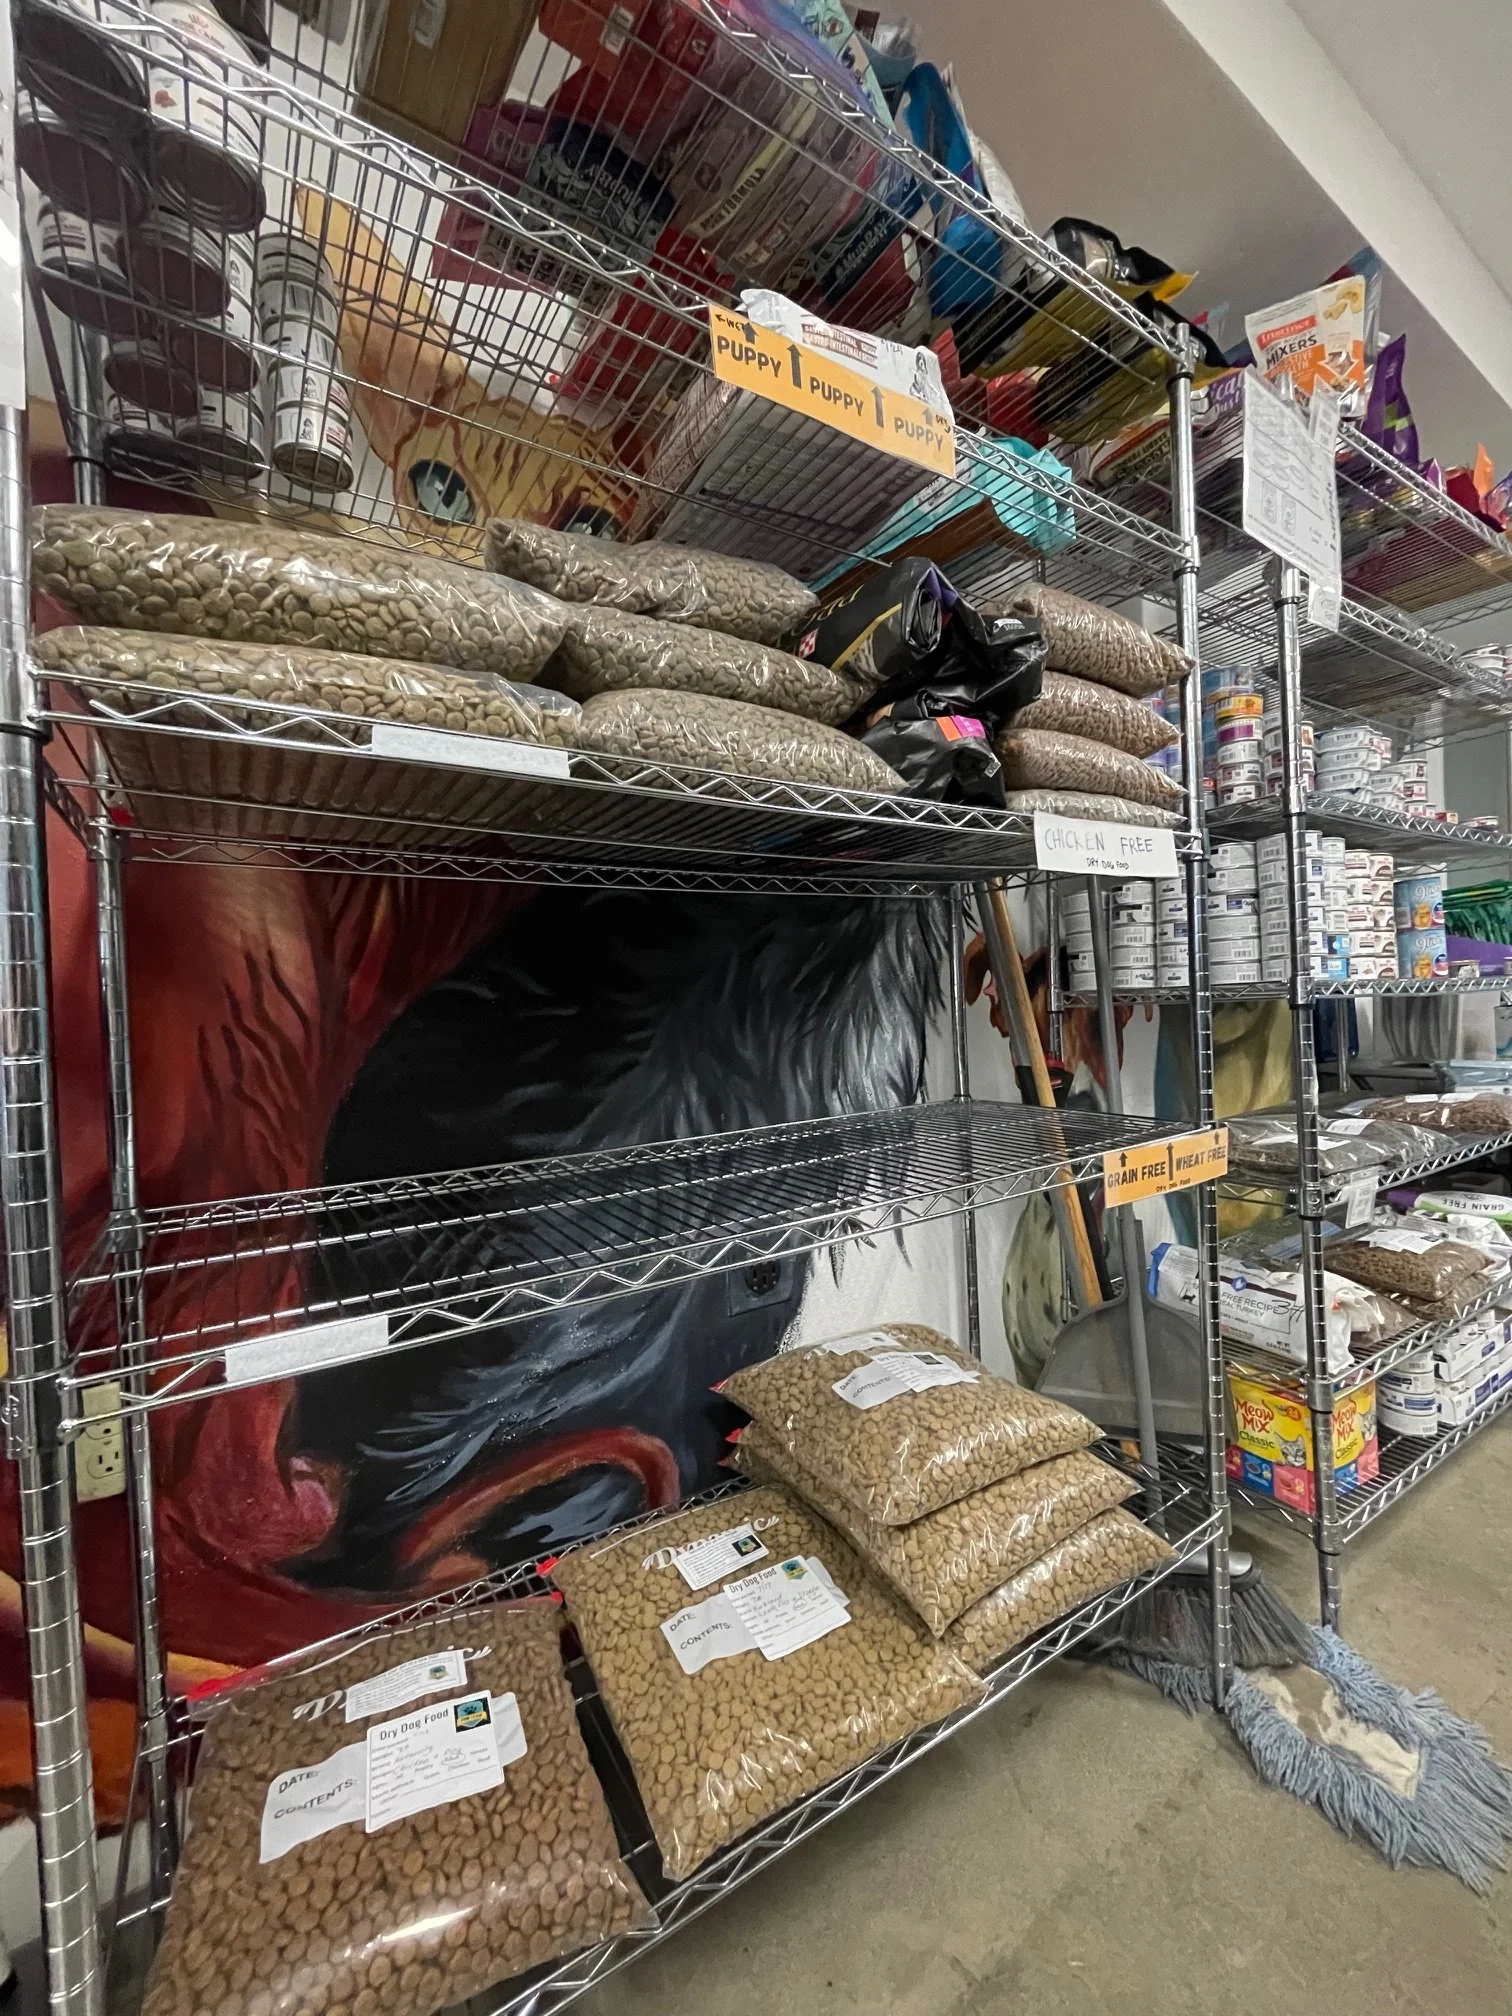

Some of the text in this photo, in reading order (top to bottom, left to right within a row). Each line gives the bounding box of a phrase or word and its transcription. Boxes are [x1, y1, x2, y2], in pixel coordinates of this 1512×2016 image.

[1266, 334, 1317, 370] MIXERS
[717, 336, 943, 451] PUPPY PUPPY PUPPY
[1045, 828, 1153, 856] CHICKEN FREE
[1086, 857, 1099, 867] DRY
[1101, 860, 1115, 869] DOG
[1107, 1145, 1226, 1188] GRAIN FREE WHEAT FREE
[1442, 1198, 1467, 1208] FREE
[1221, 1292, 1279, 1312] FREE RECIPE
[1235, 1304, 1265, 1318] TURKEY
[852, 1376, 892, 1398] CONTENTS:
[1239, 1431, 1275, 1449] Classic
[1335, 1438, 1358, 1459] Classic
[729, 1584, 743, 1594] Dry
[743, 1575, 760, 1587] Dog
[758, 1568, 777, 1582] Food
[669, 1611, 696, 1632] DATE:
[680, 1621, 733, 1650] CONTENTS:
[380, 1729, 398, 1741] Dry
[401, 1721, 421, 1734] Dog
[424, 1708, 449, 1725] Food
[278, 1770, 319, 1794] DATE:
[274, 1779, 357, 1819] CONTENTS:
